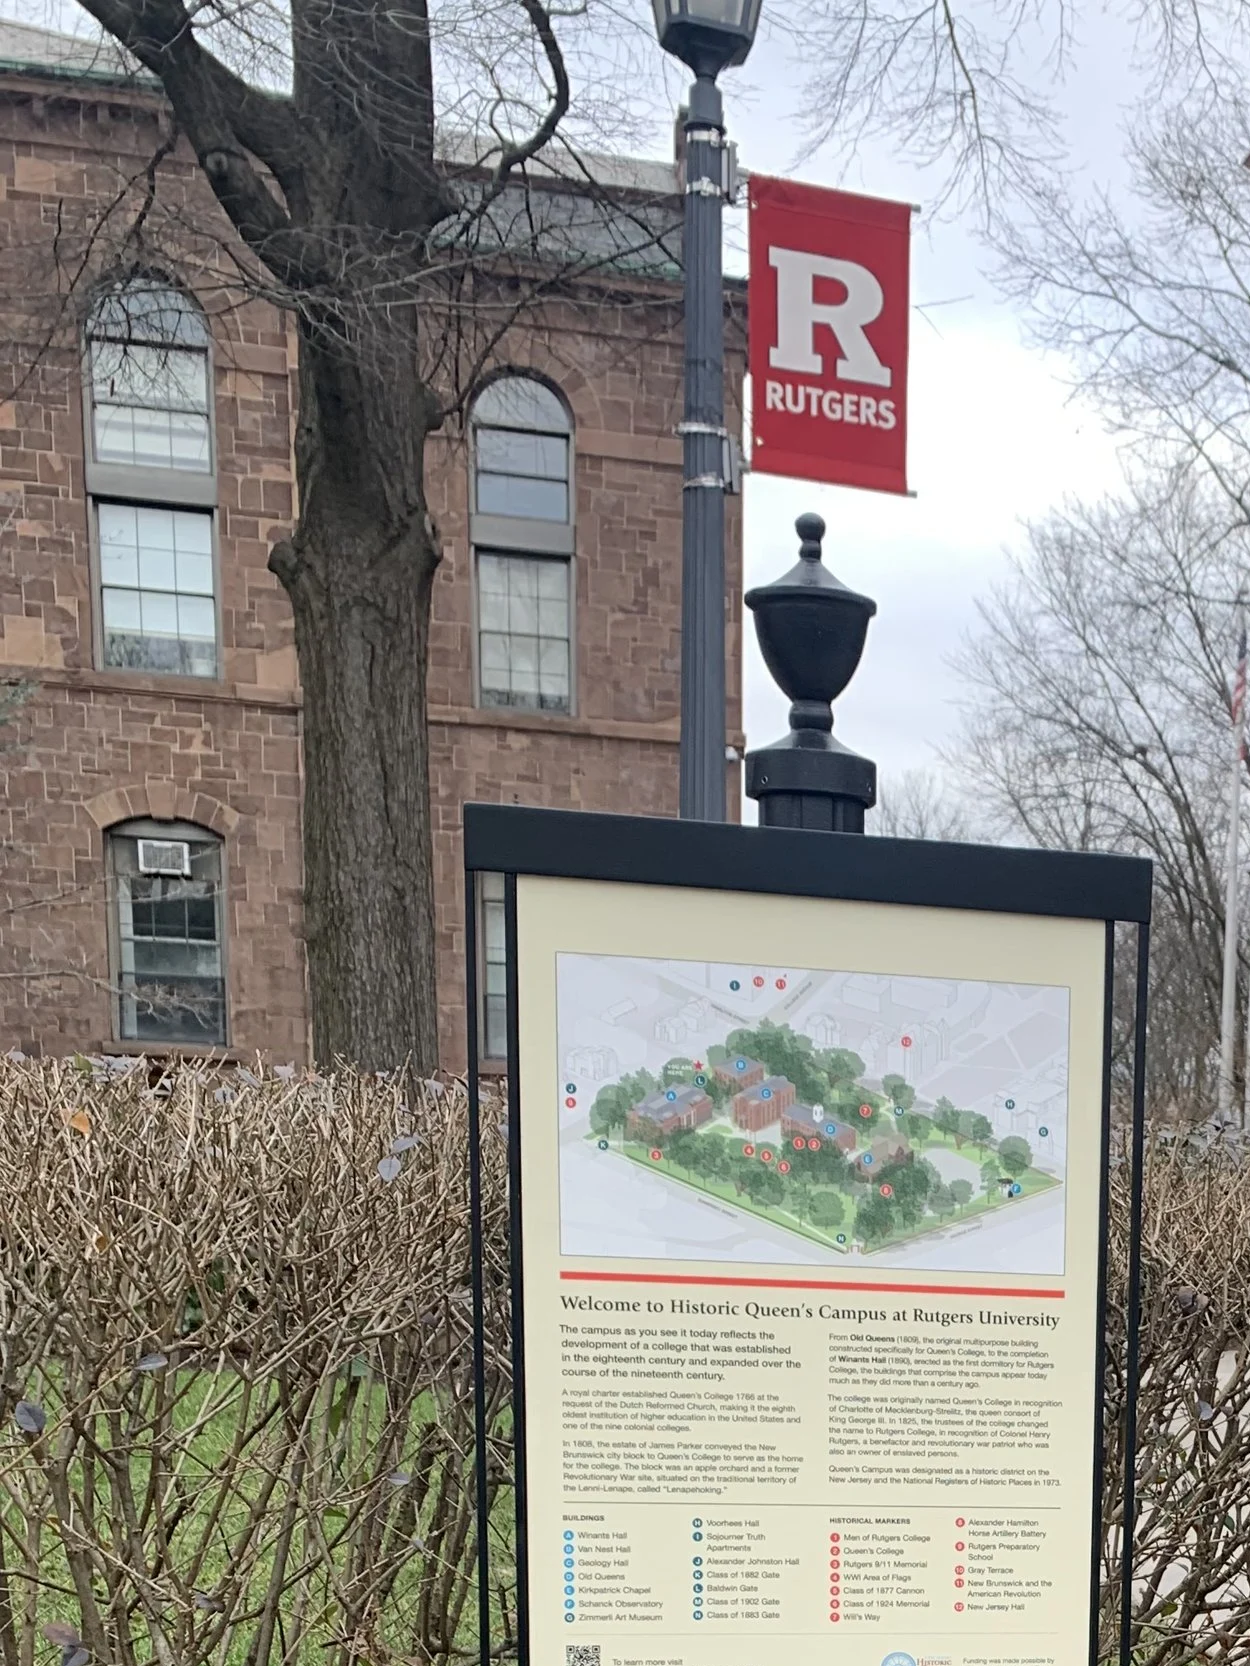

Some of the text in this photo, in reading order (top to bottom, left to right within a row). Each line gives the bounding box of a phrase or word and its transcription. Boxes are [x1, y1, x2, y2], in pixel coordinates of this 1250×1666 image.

[767, 244, 893, 389] R
[765, 380, 897, 431] RUTGERS
[559, 1294, 1060, 1330] Welcome to Historic Queen's Campus at Rutgers University
[558, 1323, 775, 1340] The campus as you see it today reflects the
[561, 1338, 627, 1351] development
[629, 1340, 640, 1349] of
[642, 1342, 649, 1350] a
[651, 1341, 688, 1353] college
[690, 1342, 710, 1352] that
[734, 1344, 791, 1354] established
[561, 1353, 801, 1368] in the eighteenth century and expanded over the
[561, 1368, 725, 1382] course of the nineteenth century.
[705, 1519, 759, 1527] Voorhees Hall
[967, 1518, 1005, 1526] Alexander
[577, 1531, 610, 1539] Winants
[706, 1532, 765, 1541] Sojourner Truth
[843, 1533, 931, 1543] Men of Rutgers College
[967, 1529, 1046, 1538] Horse Artillery Battery
[594, 1545, 613, 1553] Nest
[615, 1545, 631, 1553] Hall
[706, 1543, 751, 1552] Apartments
[843, 1546, 904, 1556] Queen's College
[967, 1542, 1040, 1552] Rutgers Preparatory
[577, 1558, 629, 1568] Geology Hall
[706, 1557, 745, 1565] Alexander
[747, 1557, 783, 1565] Johnston
[843, 1559, 873, 1569] Rutgers
[893, 1560, 927, 1568] Memorial
[706, 1570, 728, 1578] Class
[760, 1570, 780, 1578] Gate
[967, 1566, 1014, 1575] Gray Terrace
[577, 1572, 625, 1580] Old Queens
[862, 1573, 880, 1581] Area
[881, 1573, 890, 1581] of
[891, 1573, 911, 1583] Flags
[967, 1579, 1052, 1587] New Brunswick and the
[578, 1586, 651, 1595] Kirkpatrick Chapel
[706, 1584, 758, 1592] Baldwin Gate
[842, 1586, 864, 1594] Class
[895, 1586, 925, 1595] Cannon
[578, 1599, 663, 1609] Schanck Observatory
[706, 1597, 728, 1605] Class
[729, 1597, 738, 1605] of
[760, 1597, 780, 1605] Gate
[842, 1599, 864, 1607] Class
[865, 1599, 874, 1607] of
[985, 1603, 1009, 1612] Jersey
[614, 1613, 627, 1621] Art
[628, 1613, 663, 1621] Museum
[706, 1610, 729, 1619] Class
[729, 1611, 739, 1619] of
[760, 1610, 780, 1619] Gate
[863, 1613, 880, 1622] Way
[611, 1658, 622, 1666] To
